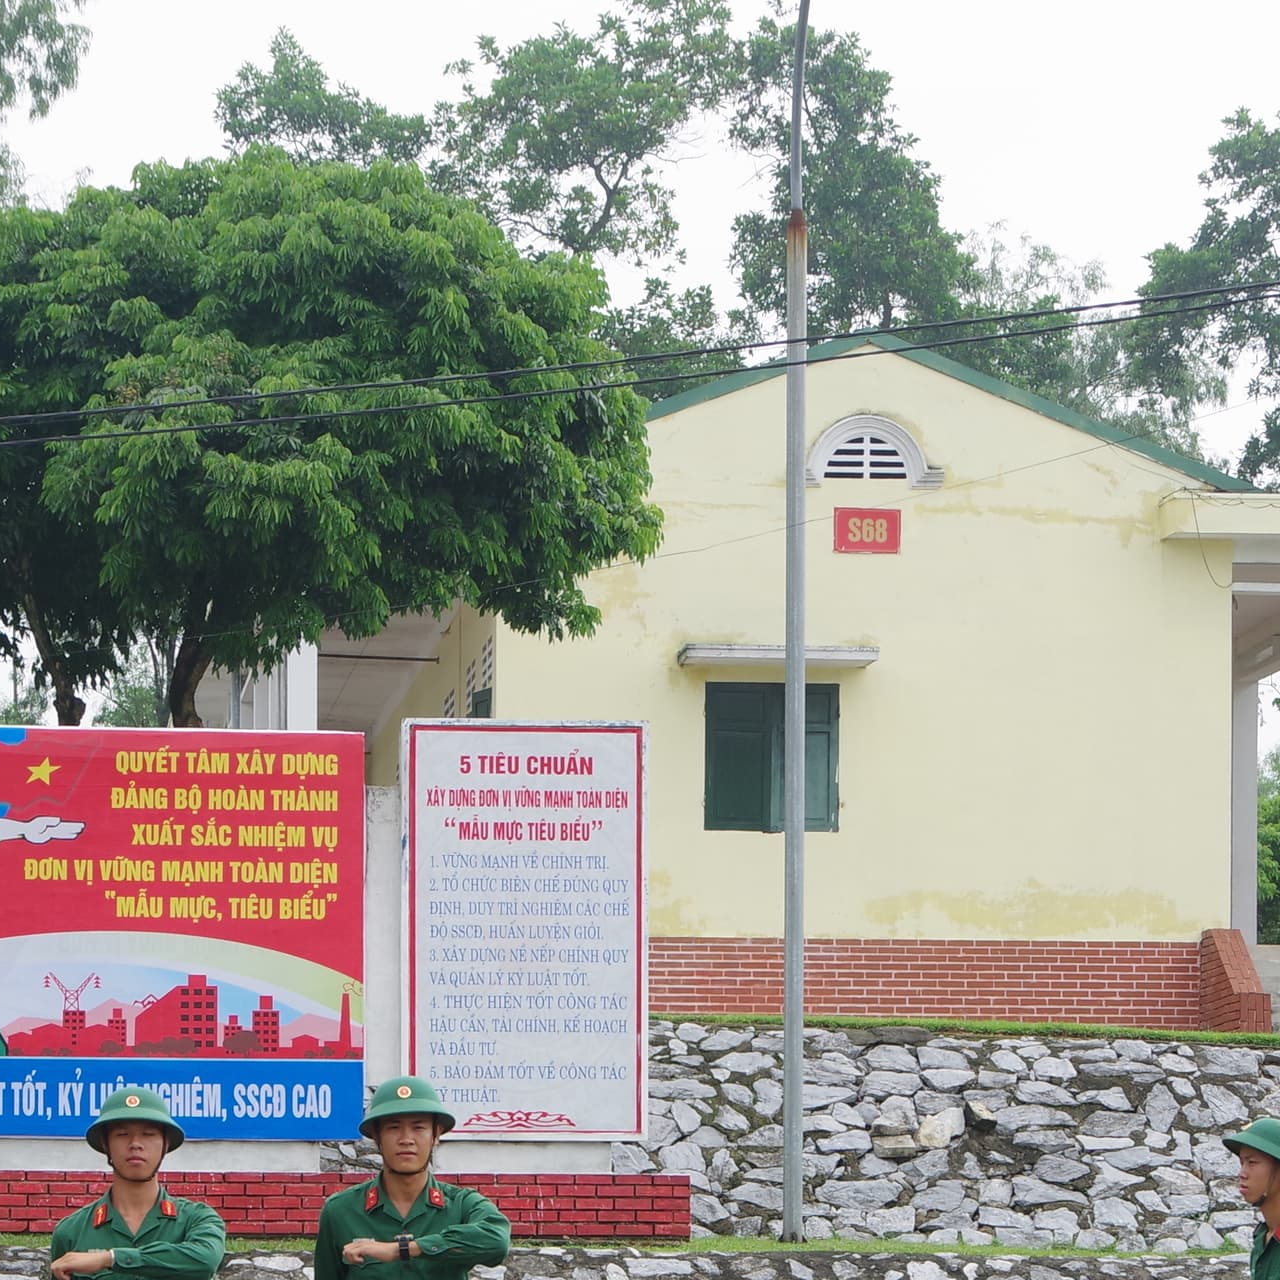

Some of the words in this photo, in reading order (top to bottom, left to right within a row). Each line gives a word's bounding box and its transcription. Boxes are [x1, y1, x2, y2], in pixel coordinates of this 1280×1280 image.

[848, 517, 887, 543] S68
[115, 745, 179, 775] QUYẾT
[186, 748, 230, 774] TÂM
[236, 749, 277, 774] XÂY
[282, 751, 338, 780] DỰNG
[459, 755, 470, 774] 5
[478, 752, 519, 774] TIÊU
[526, 748, 593, 775] CHUẨN
[111, 780, 168, 809] ĐẢNG
[174, 784, 202, 814] BỘ
[208, 785, 264, 810] HOÀN
[271, 785, 338, 811] THÀNH
[426, 785, 446, 807] XÂY
[449, 788, 476, 811] DỰNG
[479, 788, 499, 807] ĐƠN
[502, 790, 512, 811] VỊ
[515, 786, 540, 808] VỮNG
[544, 790, 573, 812] MẠNH
[577, 787, 602, 809] TOÀN
[605, 787, 628, 813] DIỆN
[131, 817, 184, 845] XUẤT
[191, 817, 232, 846] SẮC
[238, 822, 305, 852] NHIỆM
[312, 826, 338, 852] VỤ
[493, 820, 523, 845] MỰC
[528, 819, 556, 841] TIÊU
[24, 858, 68, 880] ĐƠN
[74, 859, 94, 885] VỊ
[100, 856, 155, 882] VỮNG
[161, 861, 224, 886] MẠNH
[230, 857, 283, 884] TOÀN
[290, 858, 338, 888] DIỆN
[430, 855, 440, 869] 1.
[442, 852, 478, 869] VỮNG
[480, 855, 518, 872] MẠNH
[542, 852, 582, 870] CHÍNH
[429, 879, 439, 892] 2.
[462, 875, 497, 892] CHỨC
[534, 873, 560, 893] CHẾ
[563, 875, 599, 893] ĐÚNG
[602, 879, 629, 896] QUY
[170, 895, 223, 923] MỰC,
[229, 893, 273, 919] TIÊU
[429, 901, 465, 918] ĐỊNH,
[469, 901, 495, 916] DUY
[576, 898, 601, 917] CÁC
[603, 896, 630, 917] CHẾ
[429, 921, 448, 941] ĐỘ
[450, 924, 485, 940] SSCĐ,
[489, 920, 525, 939] HUẤN
[529, 921, 571, 942] LUYỆN
[429, 949, 439, 962] 3.
[442, 945, 467, 962] XÂY
[470, 947, 506, 965] DỰNG
[530, 943, 555, 963] NẾP
[558, 945, 599, 963] CHÍNH
[602, 949, 629, 966] QUY
[488, 969, 505, 986] LÝ
[527, 968, 562, 990] LUẬT
[563, 967, 590, 986] TỐT.
[430, 995, 440, 1009] 4.
[444, 993, 484, 1011] THỰC
[487, 992, 522, 1012] HIỆN
[526, 990, 554, 1009] TỐT
[557, 992, 597, 1010] CÔNG
[600, 992, 628, 1009] TÁC
[430, 1016, 457, 1035] HẬU
[491, 1016, 513, 1033] TÀI
[515, 1015, 560, 1035] CHÍNH,
[563, 1015, 581, 1033] KẾ
[583, 1019, 628, 1037] HOẠCH
[430, 1066, 440, 1080] 5.
[508, 1059, 535, 1080] TỐT
[559, 1062, 597, 1080] CÔNG
[600, 1062, 627, 1080] TÁC
[11, 1070, 52, 1120] TỐT,
[58, 1068, 84, 1116] KỶ
[233, 1083, 286, 1118] SSCĐ
[292, 1084, 332, 1118] CAO
[451, 1085, 501, 1106] THUẬT.
